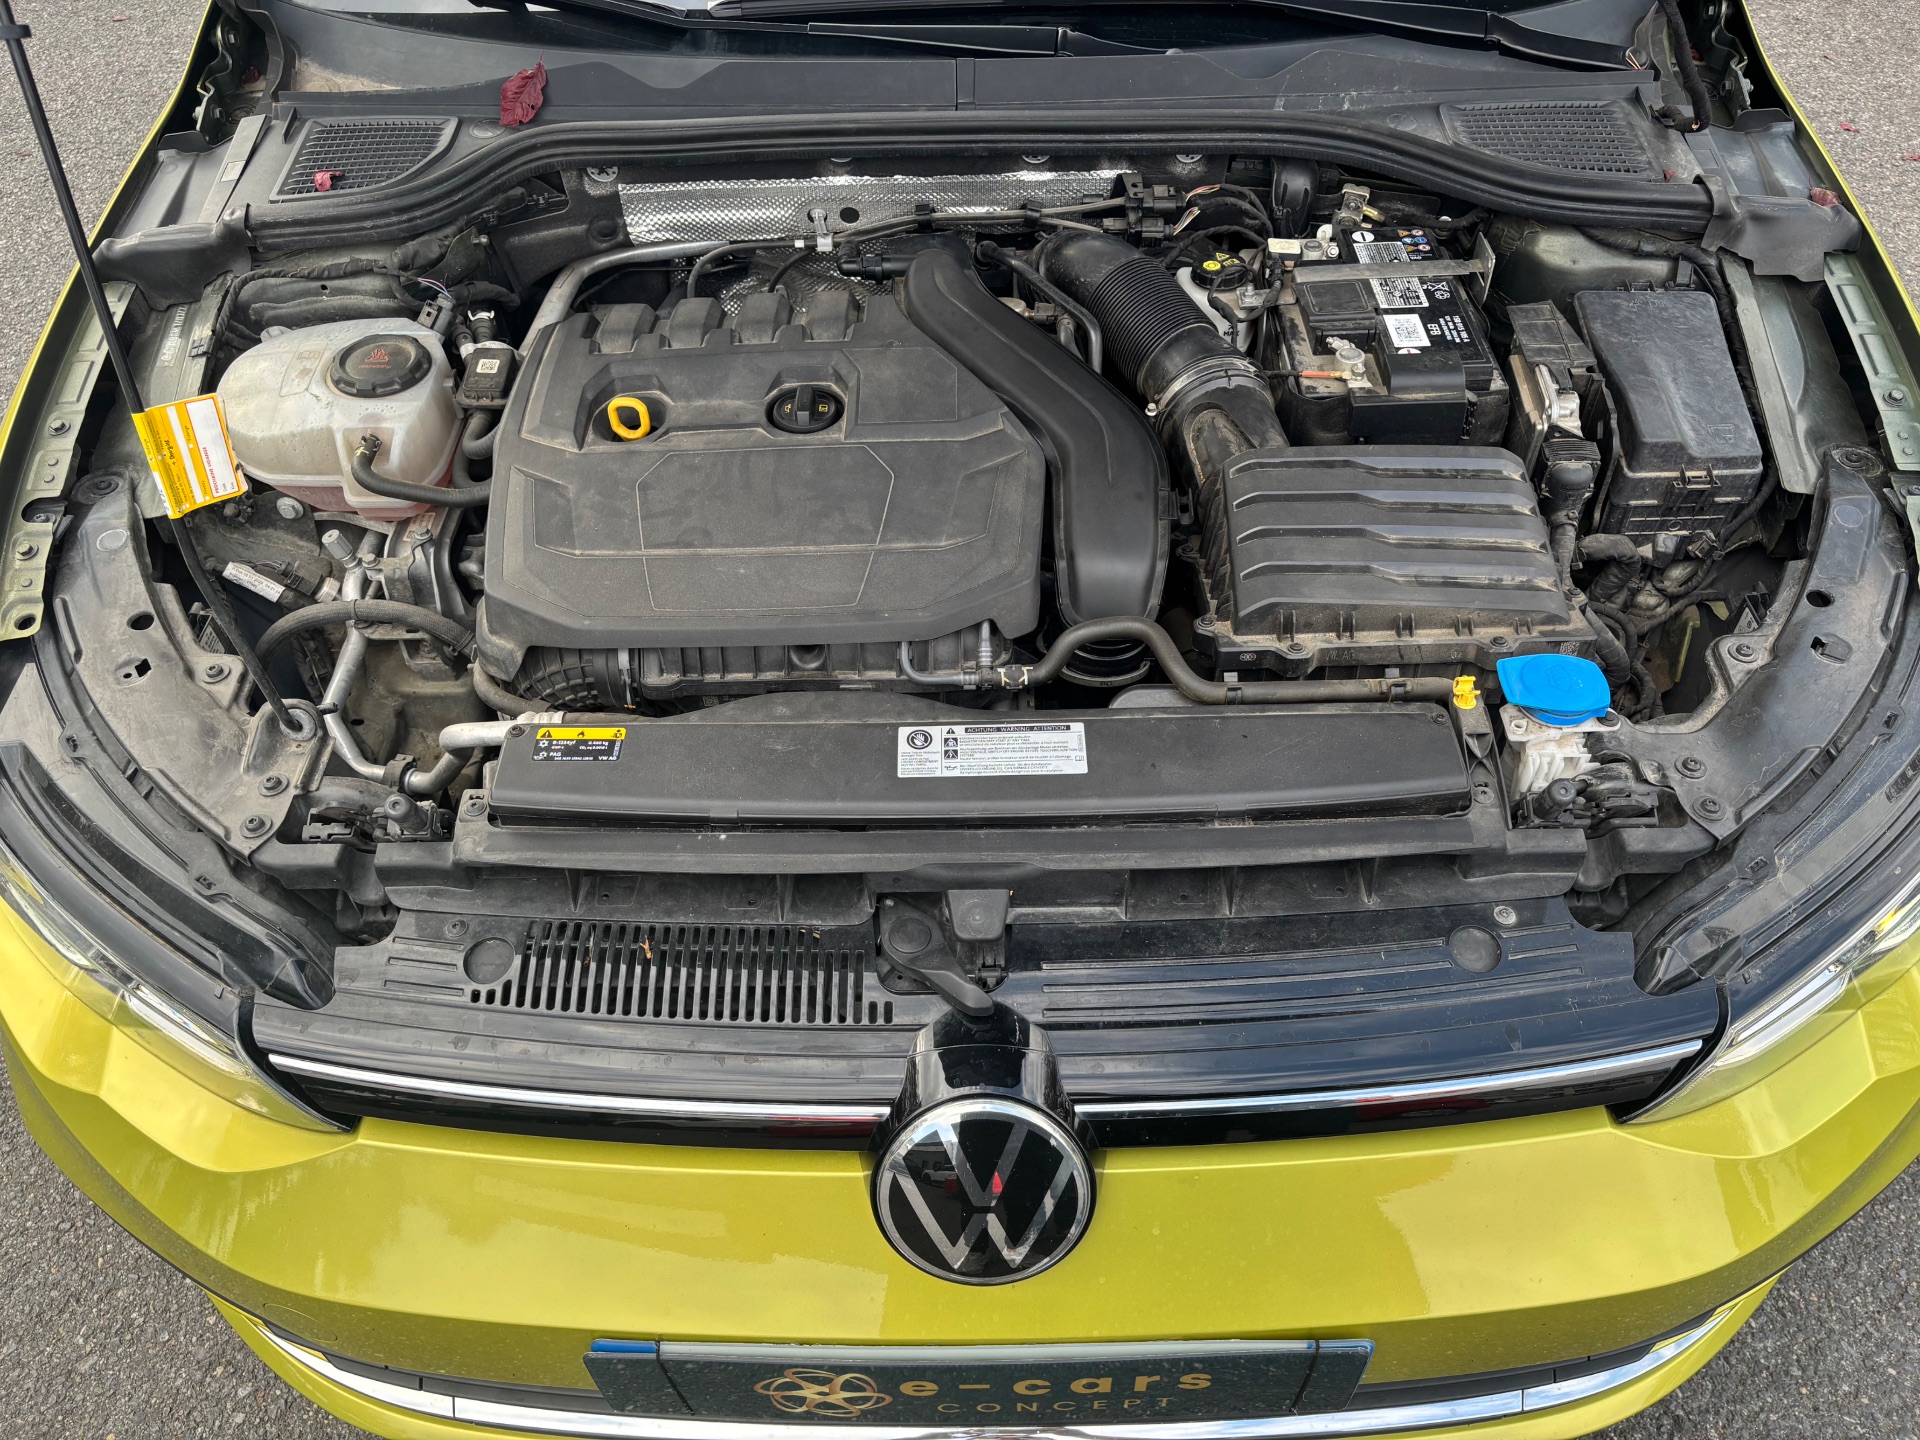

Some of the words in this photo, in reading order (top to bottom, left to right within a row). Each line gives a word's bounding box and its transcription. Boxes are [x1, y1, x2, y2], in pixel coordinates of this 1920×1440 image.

[1426, 323, 1442, 336] EFB
[900, 1373, 1213, 1397] e-cars
[937, 1397, 1174, 1413] CONCEPT
